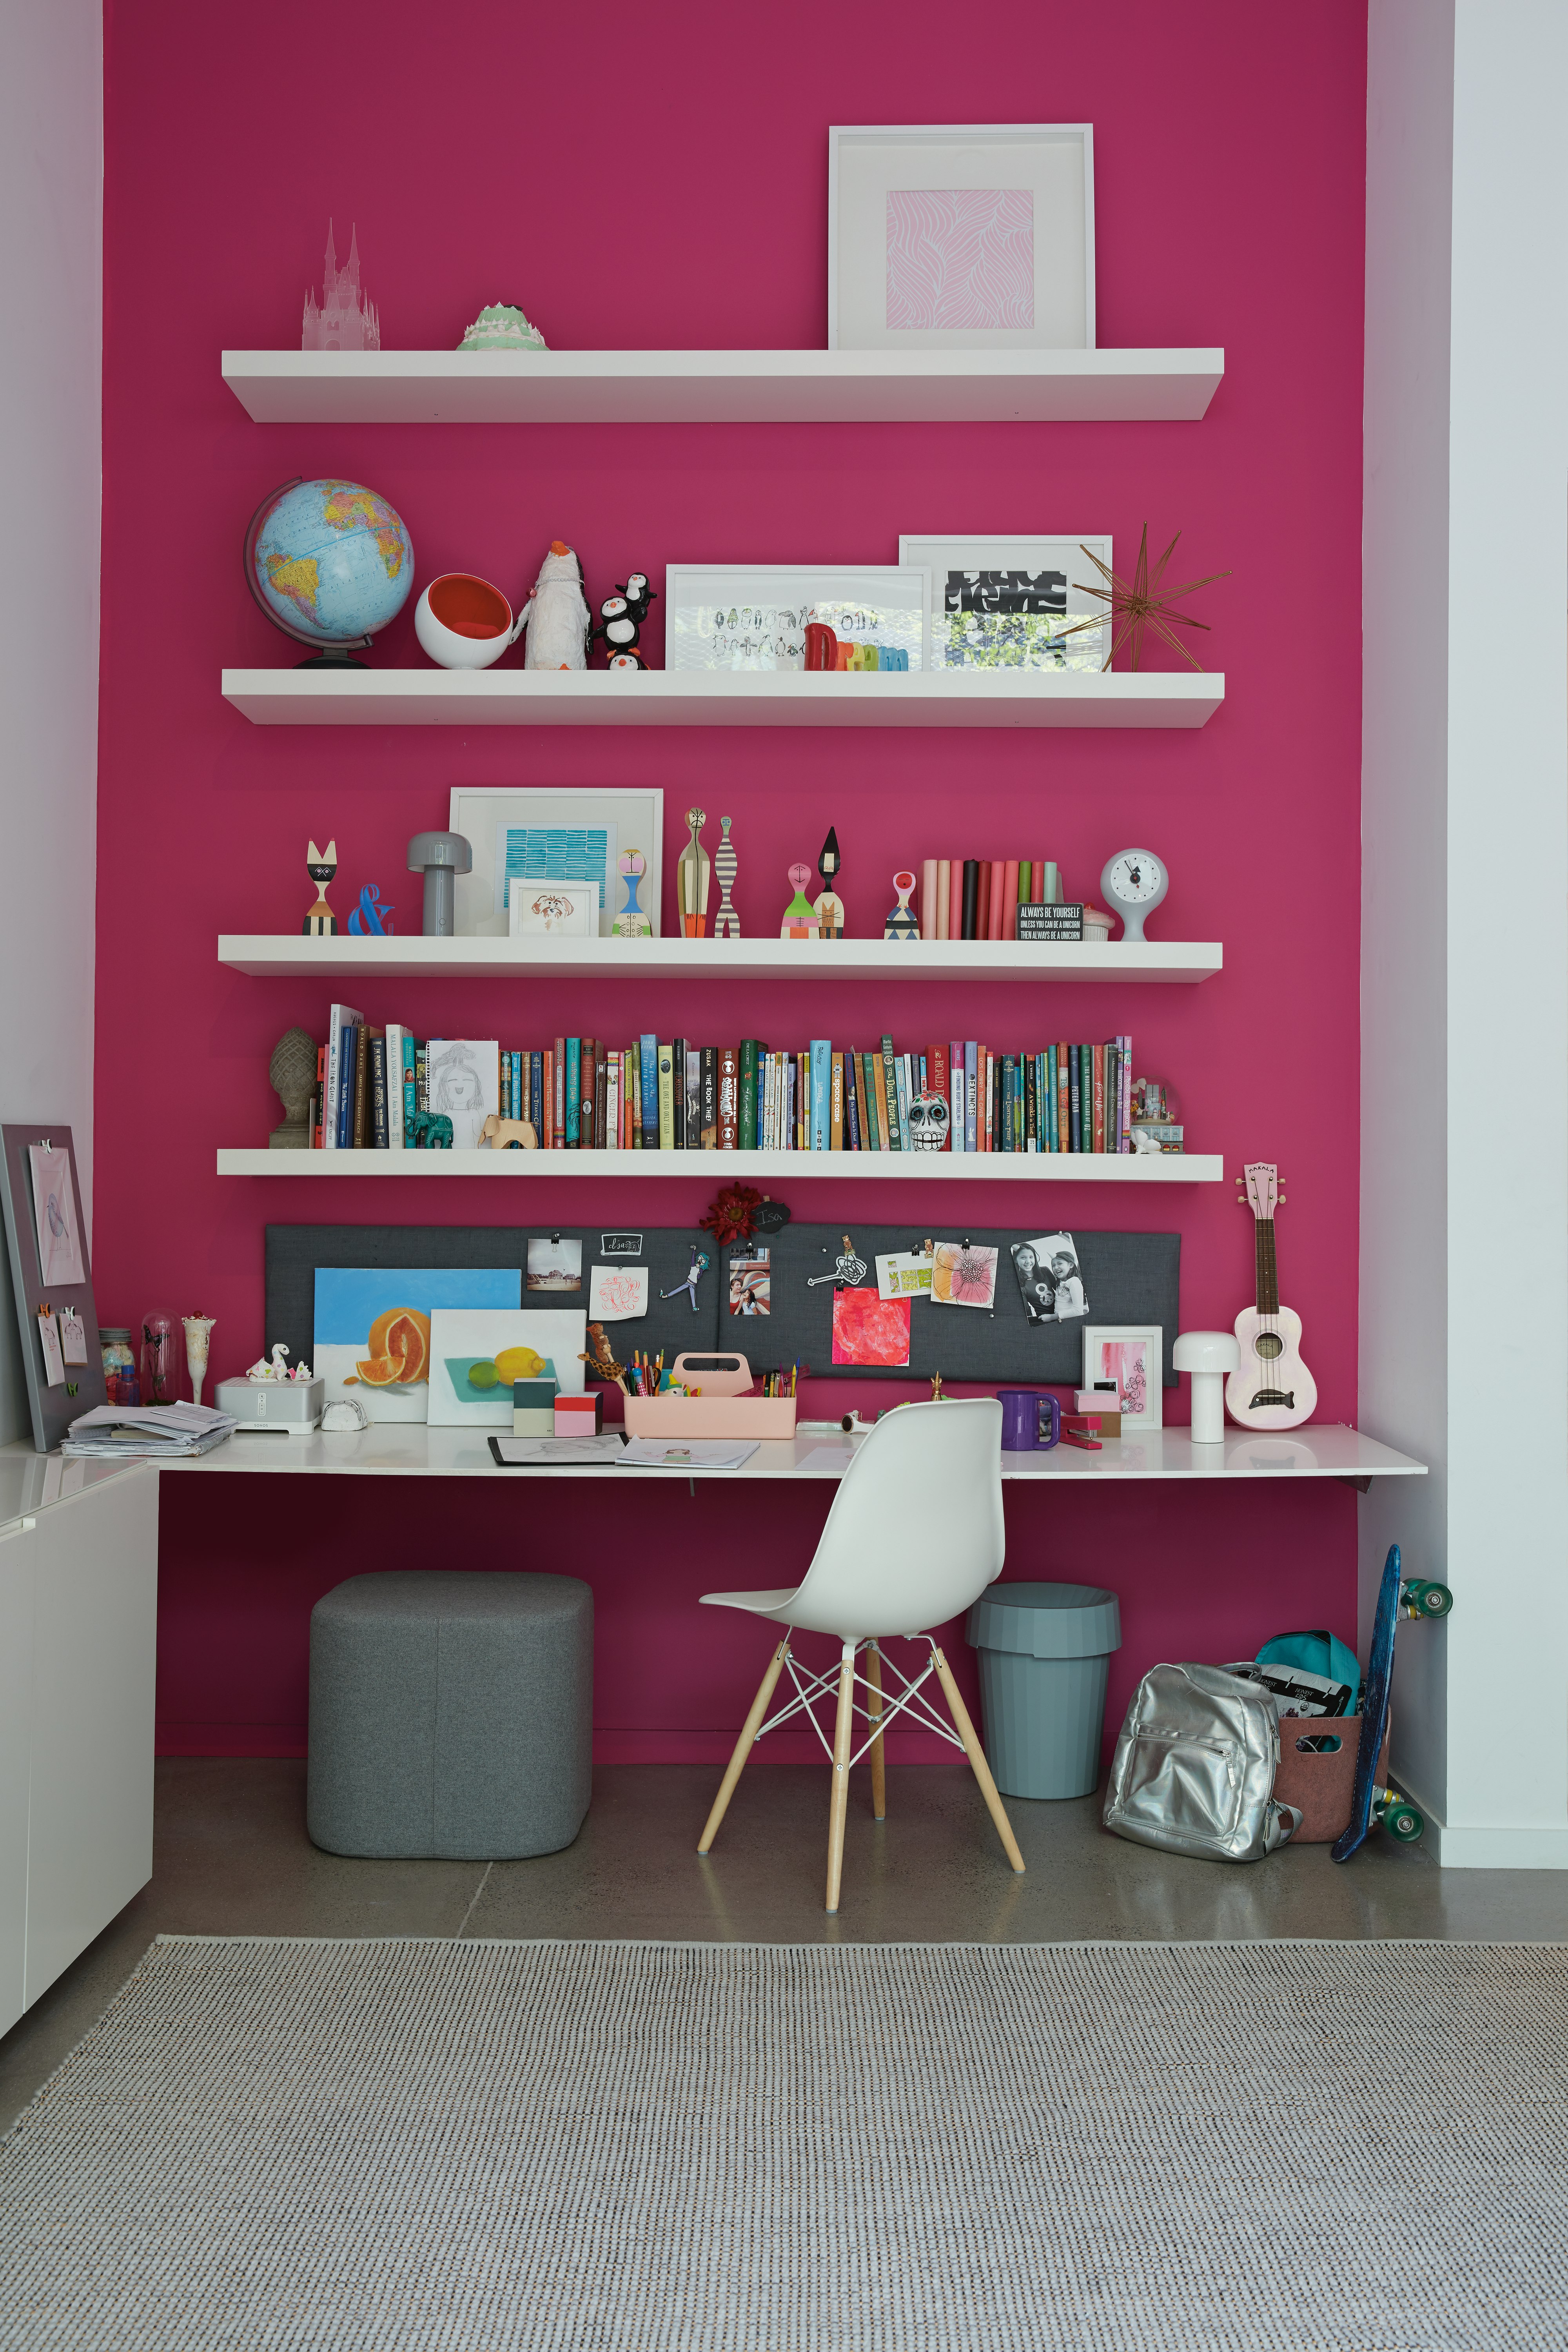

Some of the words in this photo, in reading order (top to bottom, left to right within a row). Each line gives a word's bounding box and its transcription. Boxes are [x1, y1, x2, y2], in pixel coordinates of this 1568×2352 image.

[278, 507, 301, 520] NORTH
[283, 527, 306, 539] OCEAN
[329, 540, 356, 552] SOUTH
[331, 571, 375, 589] ATLANTIC
[357, 601, 383, 611] OCEAN
[1021, 907, 1043, 917] ALWAYS
[1045, 907, 1051, 917] BE
[1053, 907, 1080, 918] YOURSELF
[935, 1060, 944, 1087] ROALD
[886, 1080, 895, 1098] DOLL
[720, 1077, 733, 1116] CANDYMAKERS
[393, 1100, 397, 1109] Am
[1061, 1098, 1067, 1109] GO
[888, 1100, 897, 1125] PEOPLE
[756, 1210, 782, 1225] Isa
